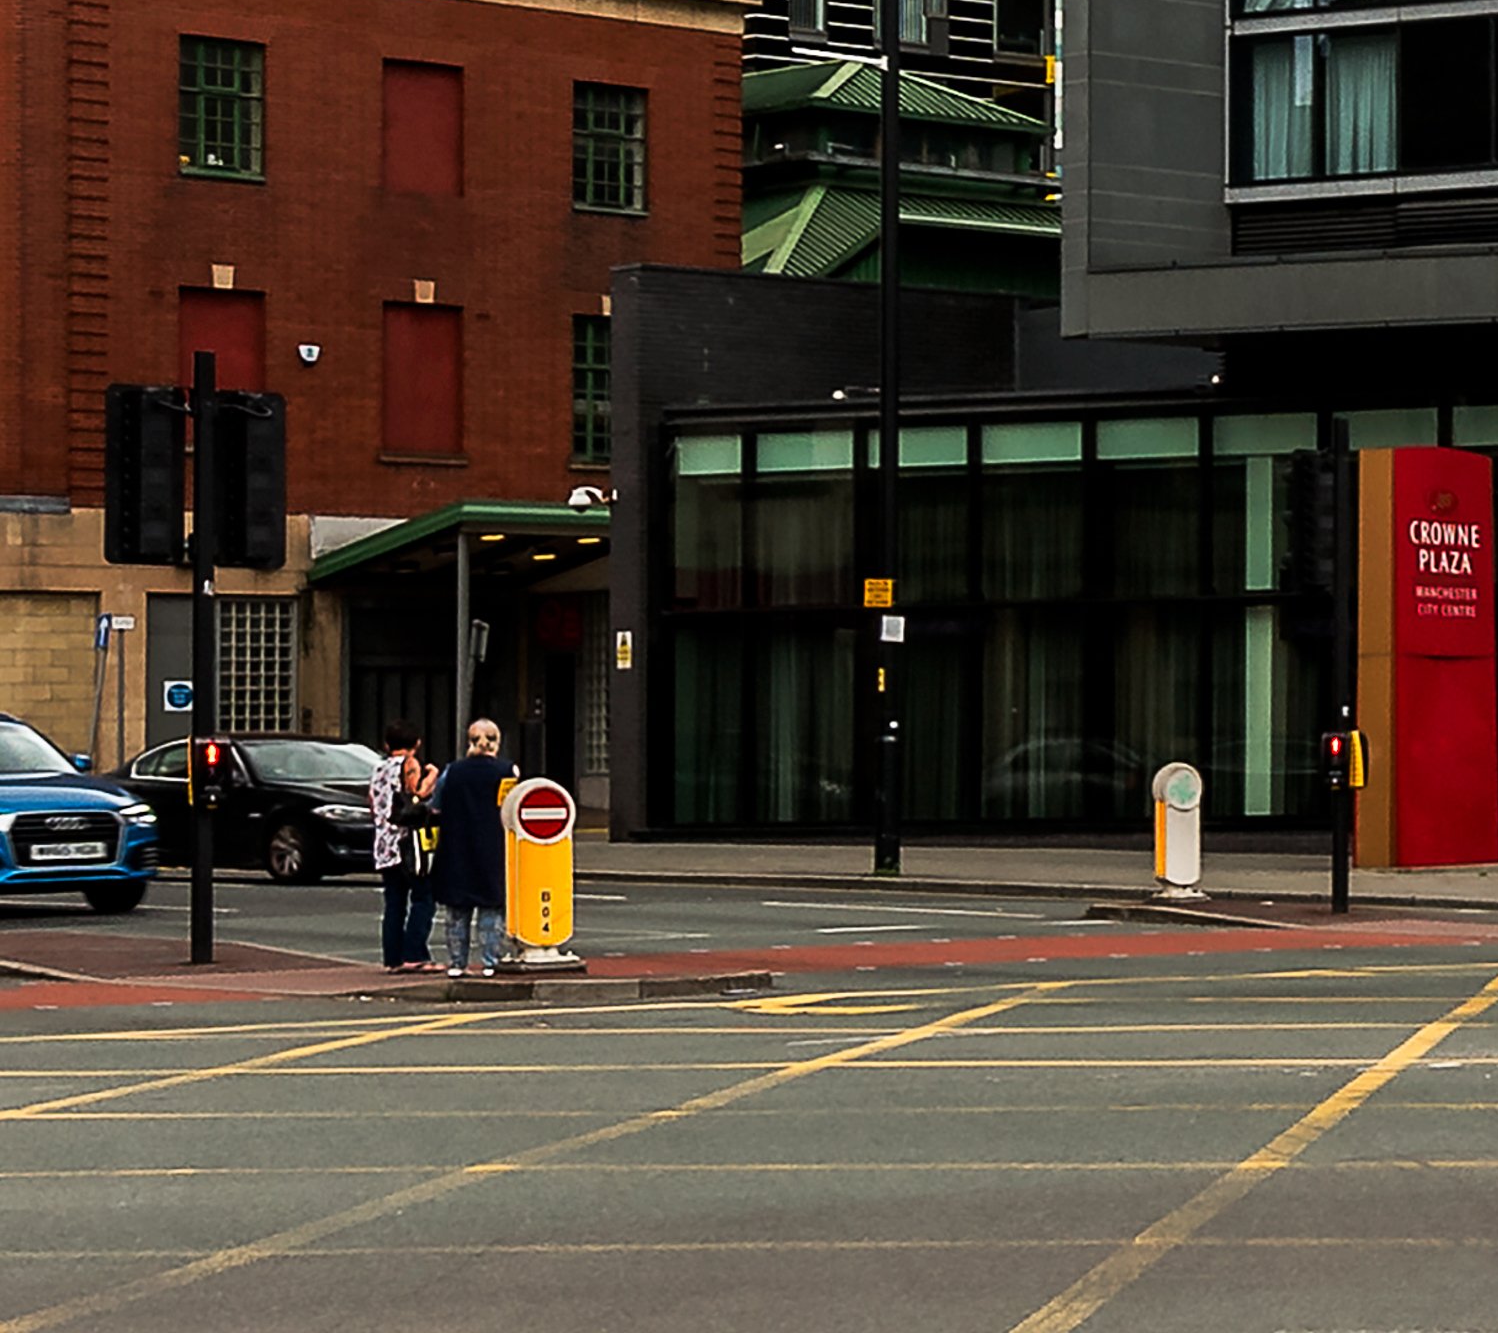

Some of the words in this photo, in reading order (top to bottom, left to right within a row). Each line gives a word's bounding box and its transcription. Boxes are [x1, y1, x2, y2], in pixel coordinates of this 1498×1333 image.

[1409, 520, 1481, 548] CROWNE
[1419, 548, 1473, 575] PLAZA
[1415, 585, 1478, 600] MANCHESTER
[1417, 602, 1439, 616] CITY
[1440, 604, 1477, 618] CENTRE
